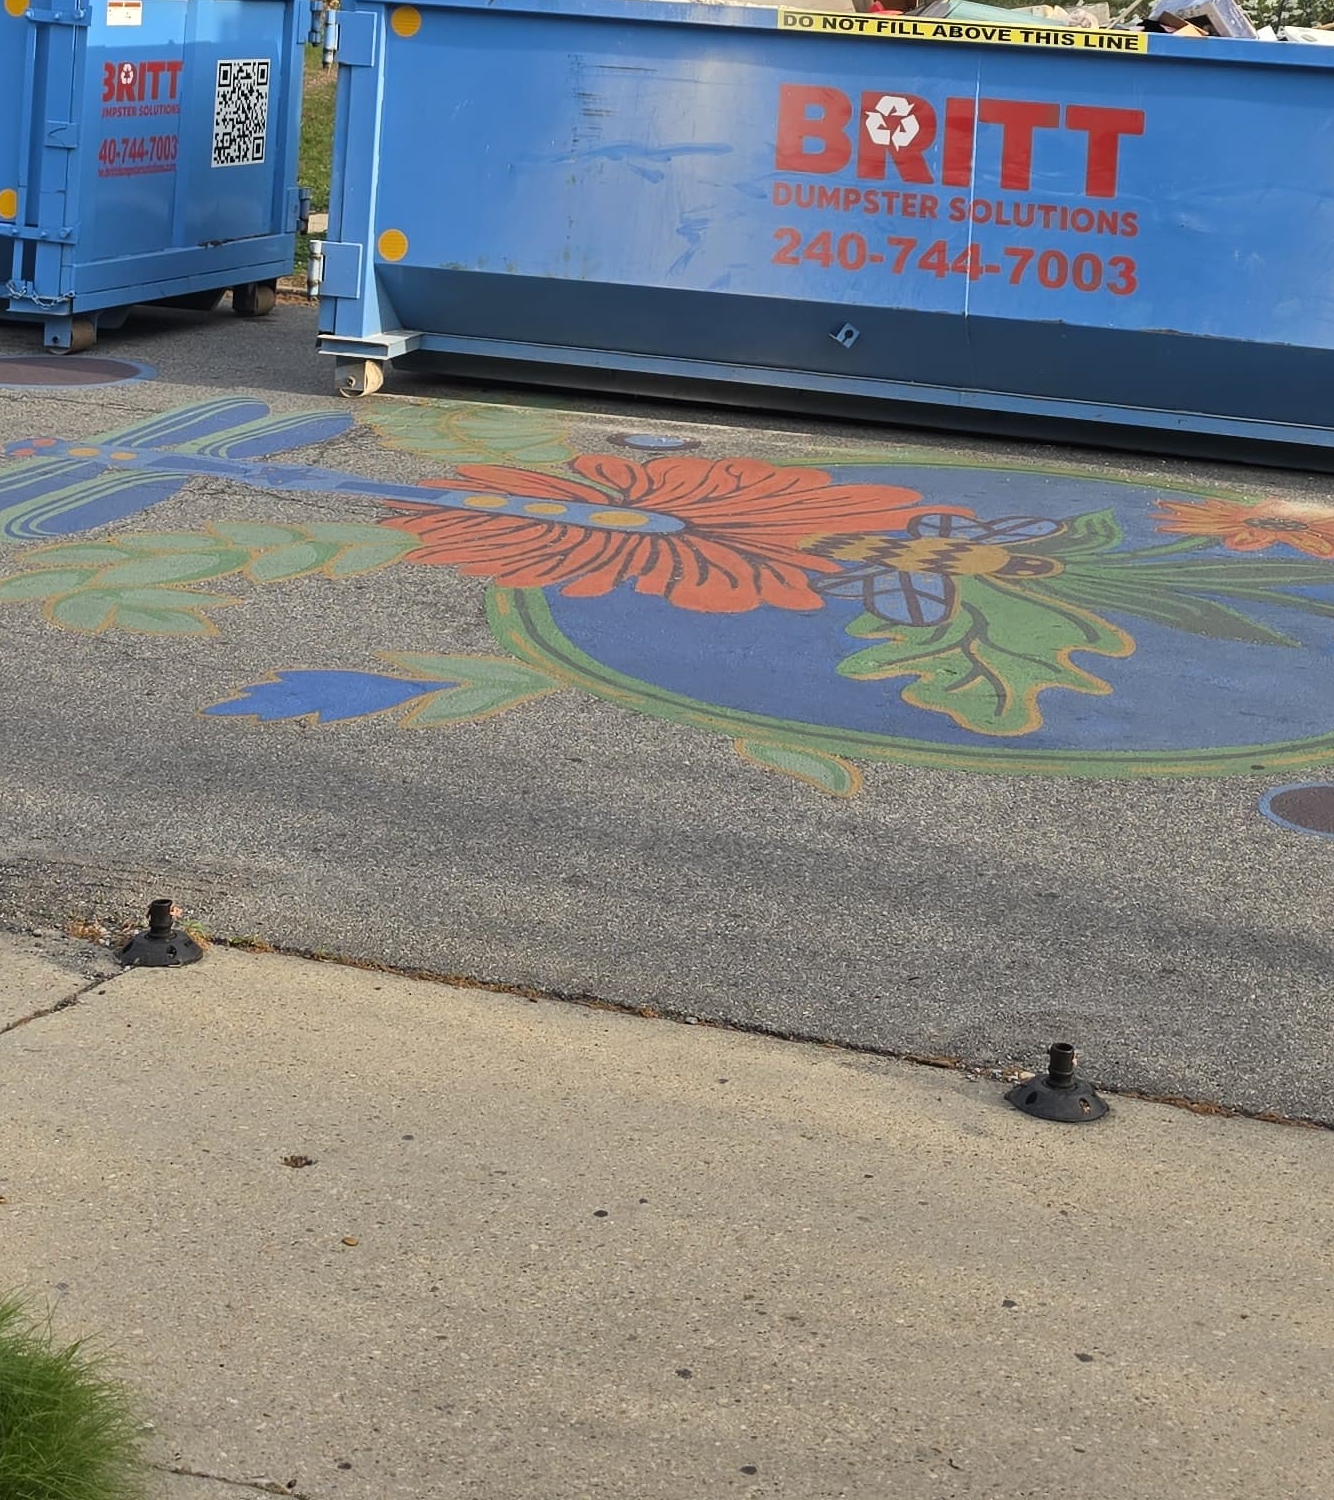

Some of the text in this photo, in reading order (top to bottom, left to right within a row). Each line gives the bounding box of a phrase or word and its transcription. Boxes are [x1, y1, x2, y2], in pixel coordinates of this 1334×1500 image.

[783, 14, 1139, 50] DO NOT FILL ABOVE THIS LINE
[139, 104, 181, 117] SOLUTIONS
[774, 83, 1145, 198] BRITT
[772, 181, 1139, 238] DUMPSTER SOLUTIONS
[771, 227, 1139, 296] 240-744-7003
